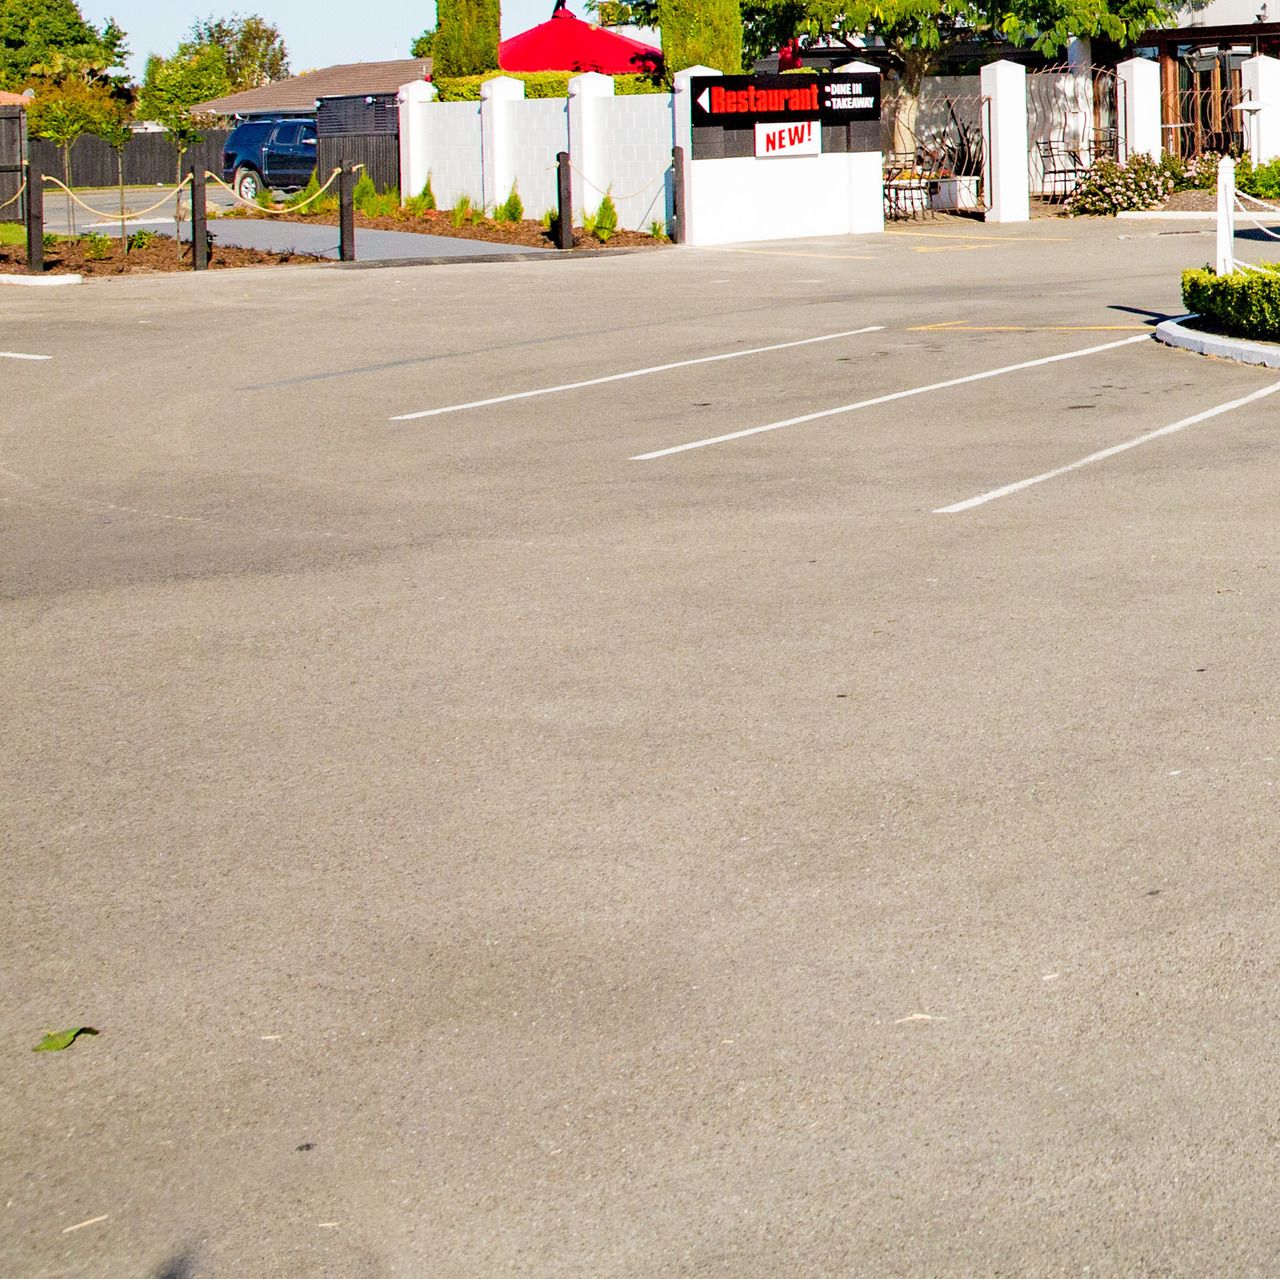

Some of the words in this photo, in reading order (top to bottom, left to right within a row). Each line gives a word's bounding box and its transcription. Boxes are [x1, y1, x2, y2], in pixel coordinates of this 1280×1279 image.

[711, 84, 820, 114] Restaurant
[830, 84, 852, 95] DINE
[852, 83, 862, 94] IN
[831, 96, 874, 110] TAKEAWAY
[766, 121, 812, 152] NEW!
